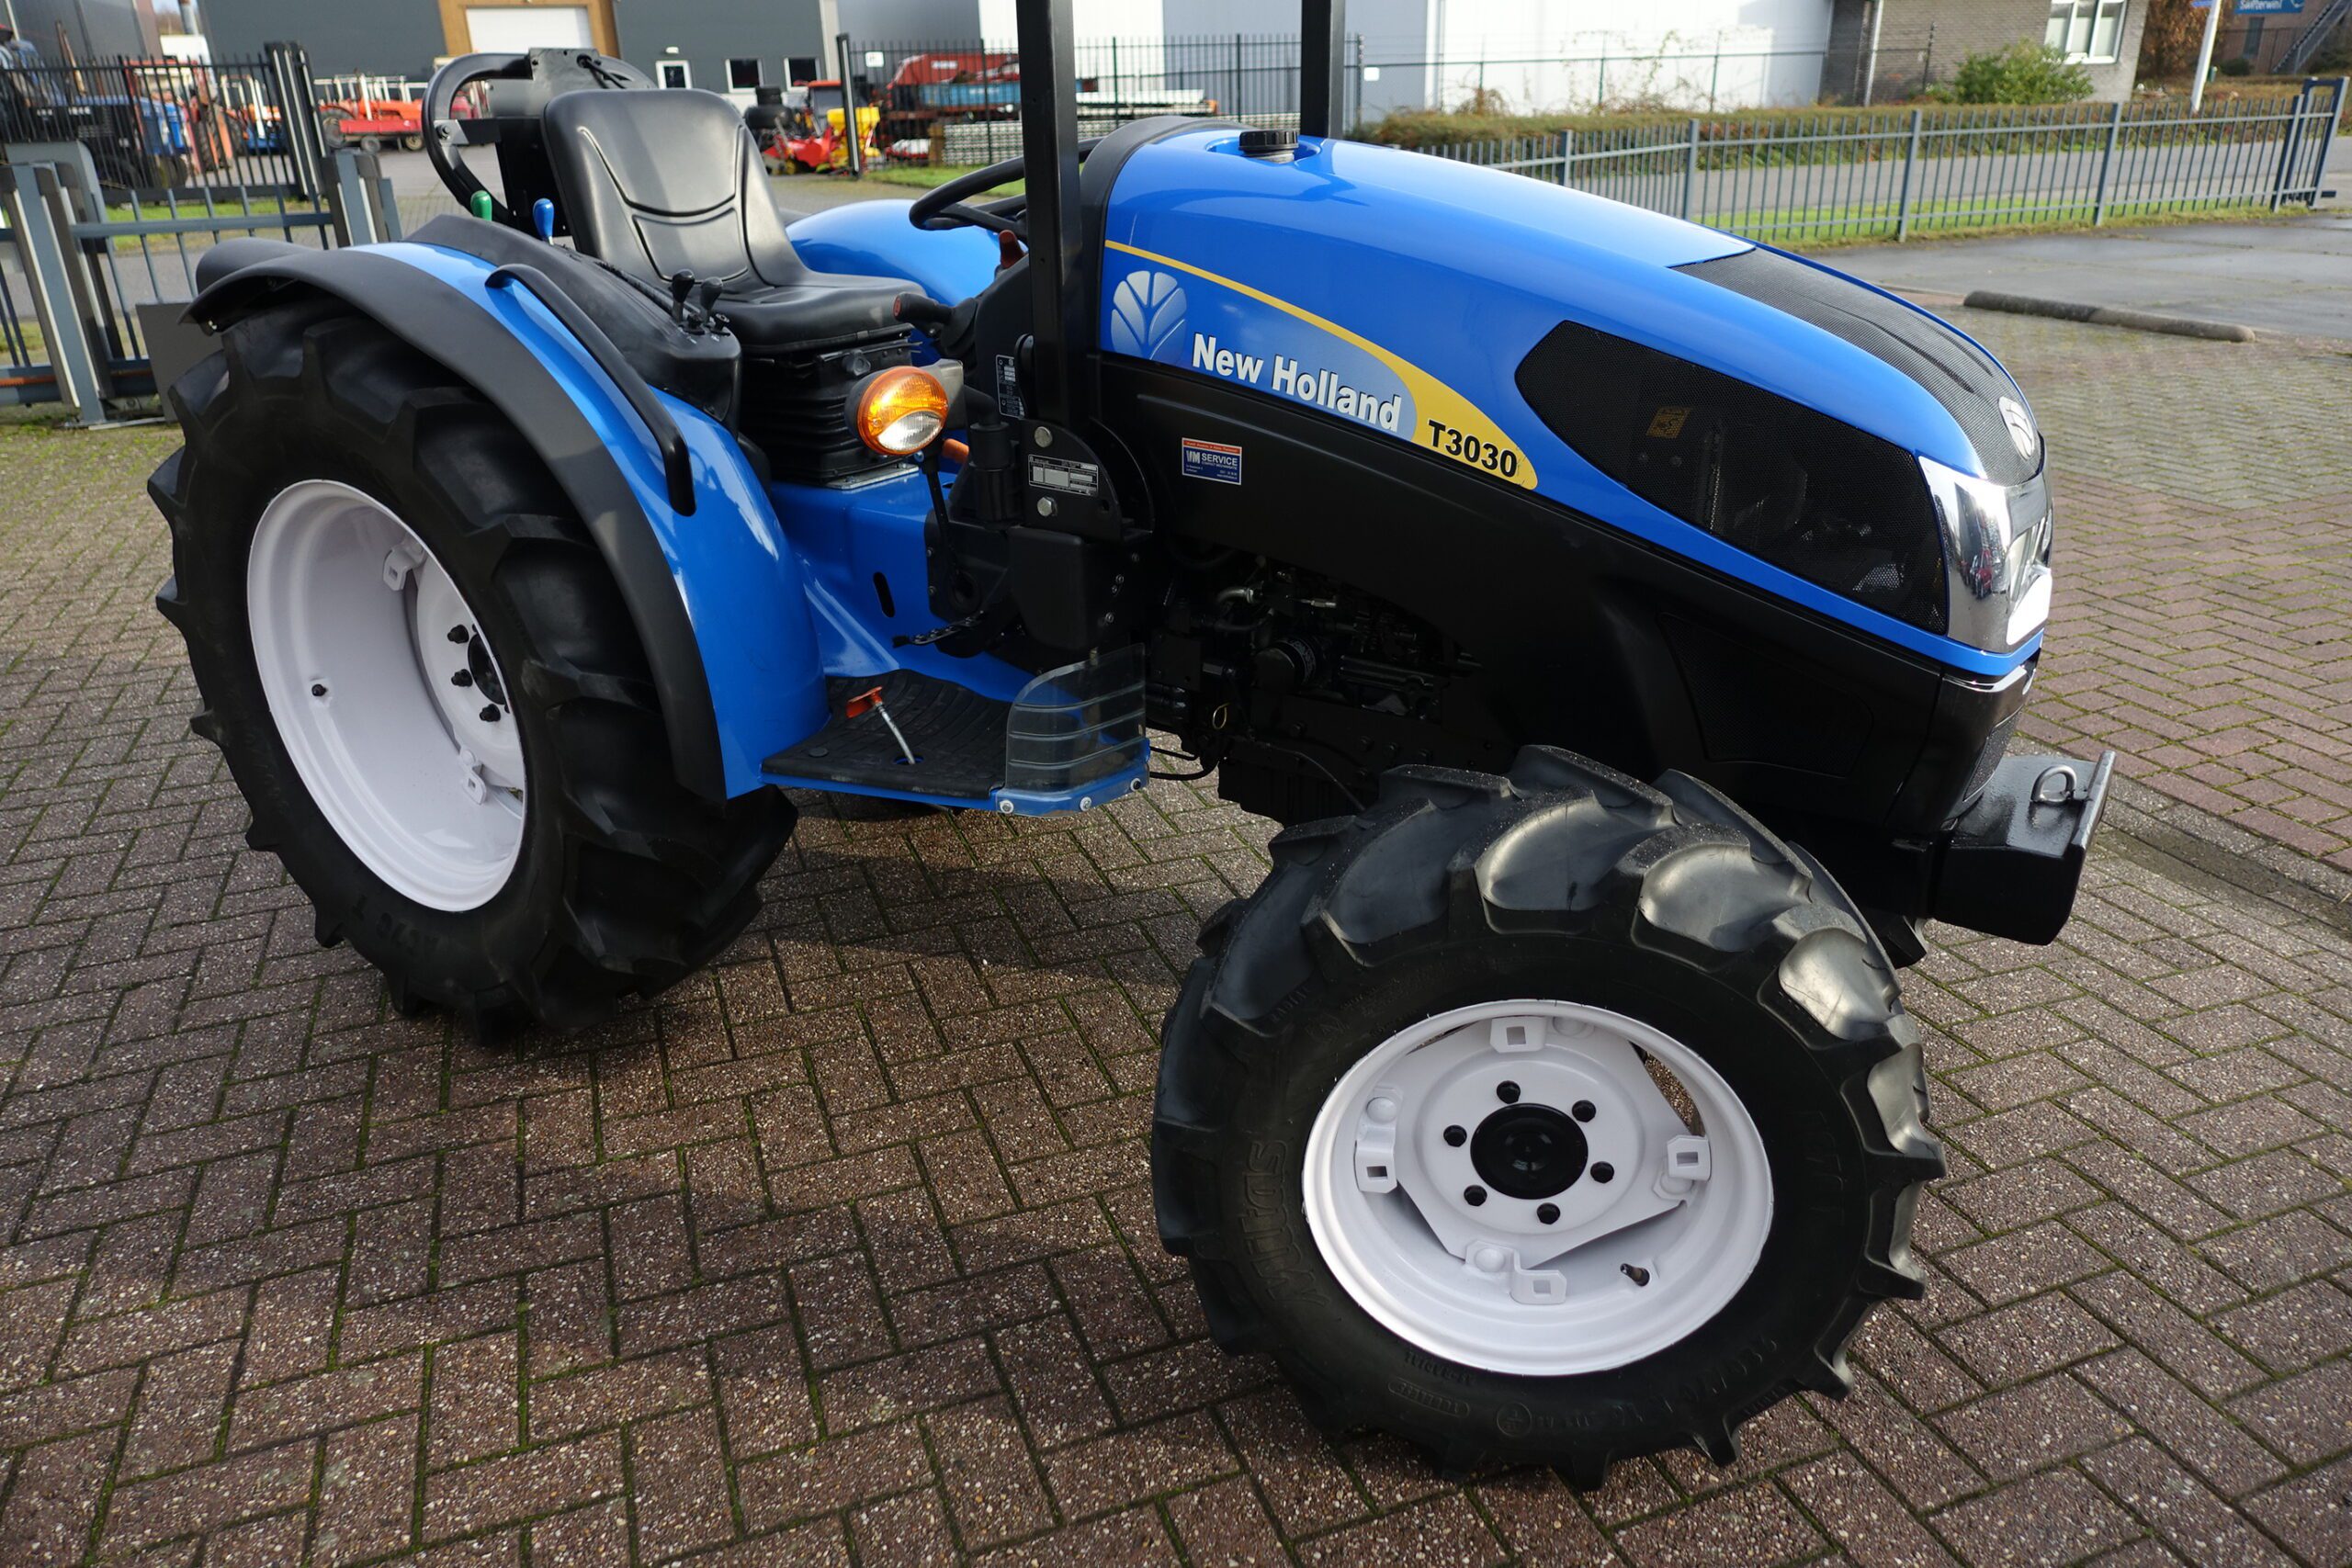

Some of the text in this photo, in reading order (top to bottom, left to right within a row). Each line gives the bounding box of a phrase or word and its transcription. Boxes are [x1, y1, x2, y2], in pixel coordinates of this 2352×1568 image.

[1192, 332, 1402, 433] New Holland
[1201, 452, 1238, 467] SERVICE
[1427, 419, 1519, 479] T3030
[1238, 1139, 1332, 1308] Mitas
